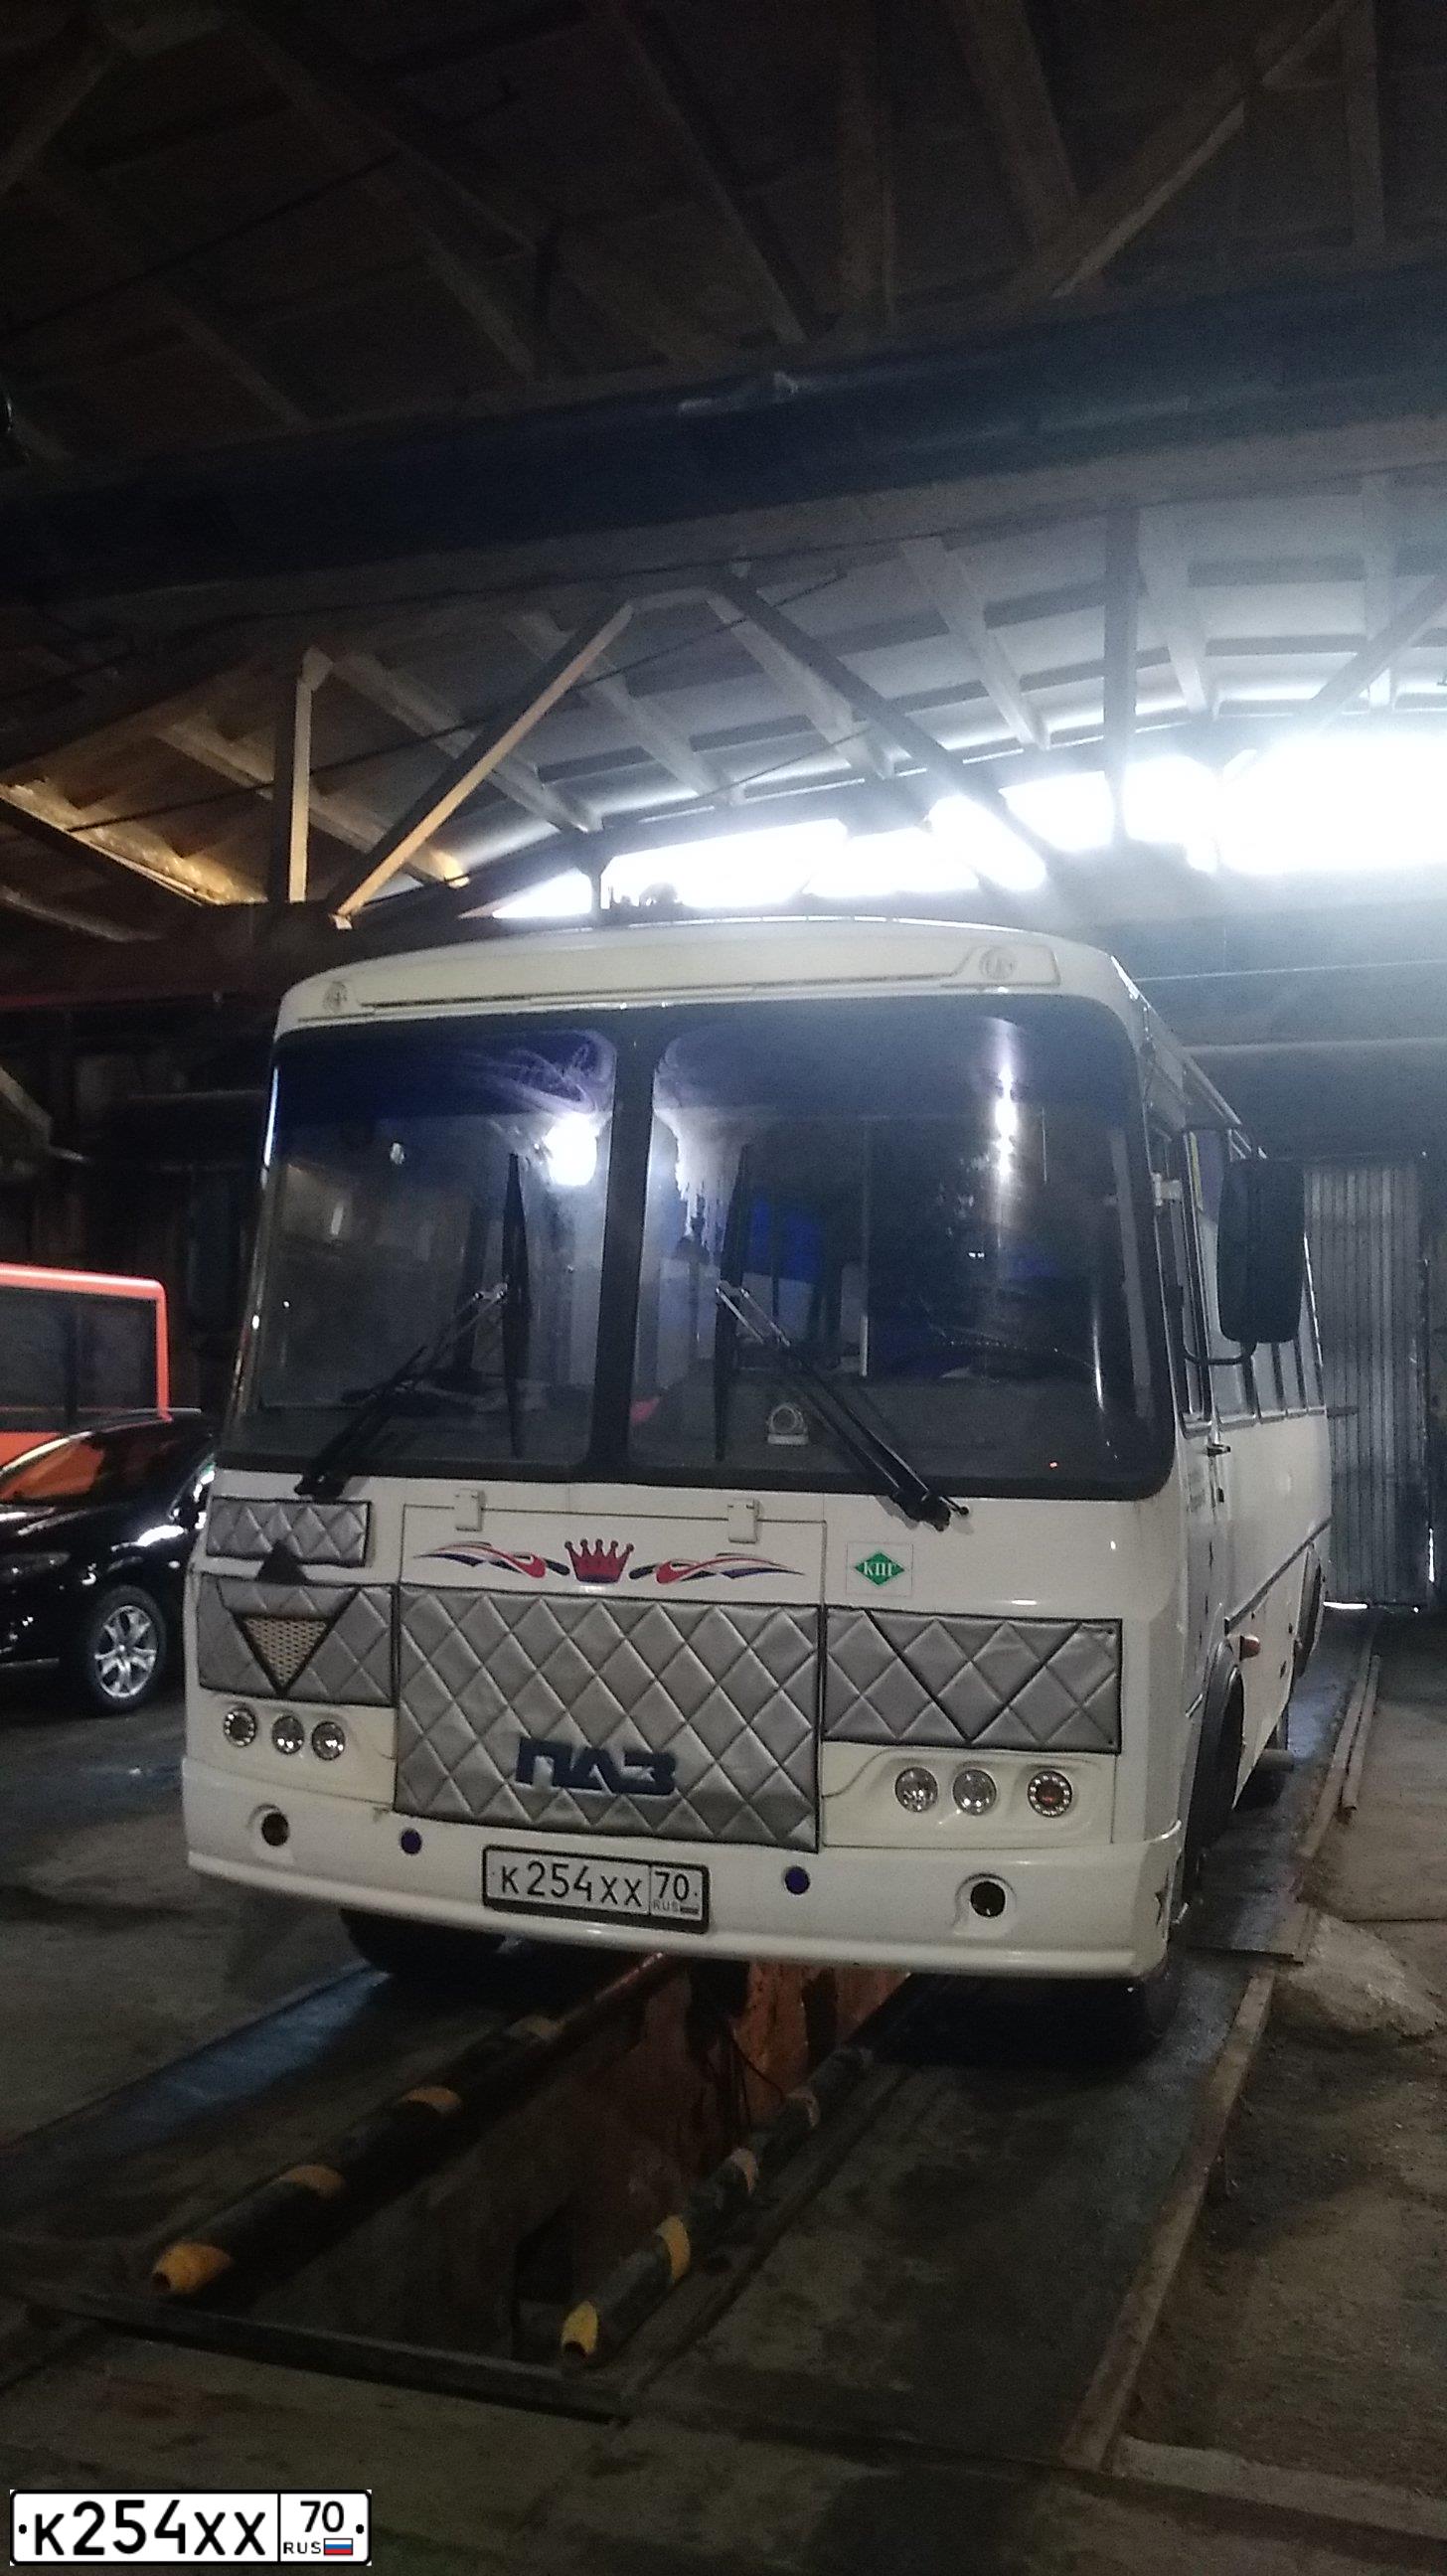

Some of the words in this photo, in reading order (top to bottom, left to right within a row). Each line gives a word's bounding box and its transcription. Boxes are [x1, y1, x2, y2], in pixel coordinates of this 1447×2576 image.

[516, 1739, 676, 1795] ПАЗ
[655, 1870, 690, 1901] 70
[653, 1899, 681, 1913] RUS
